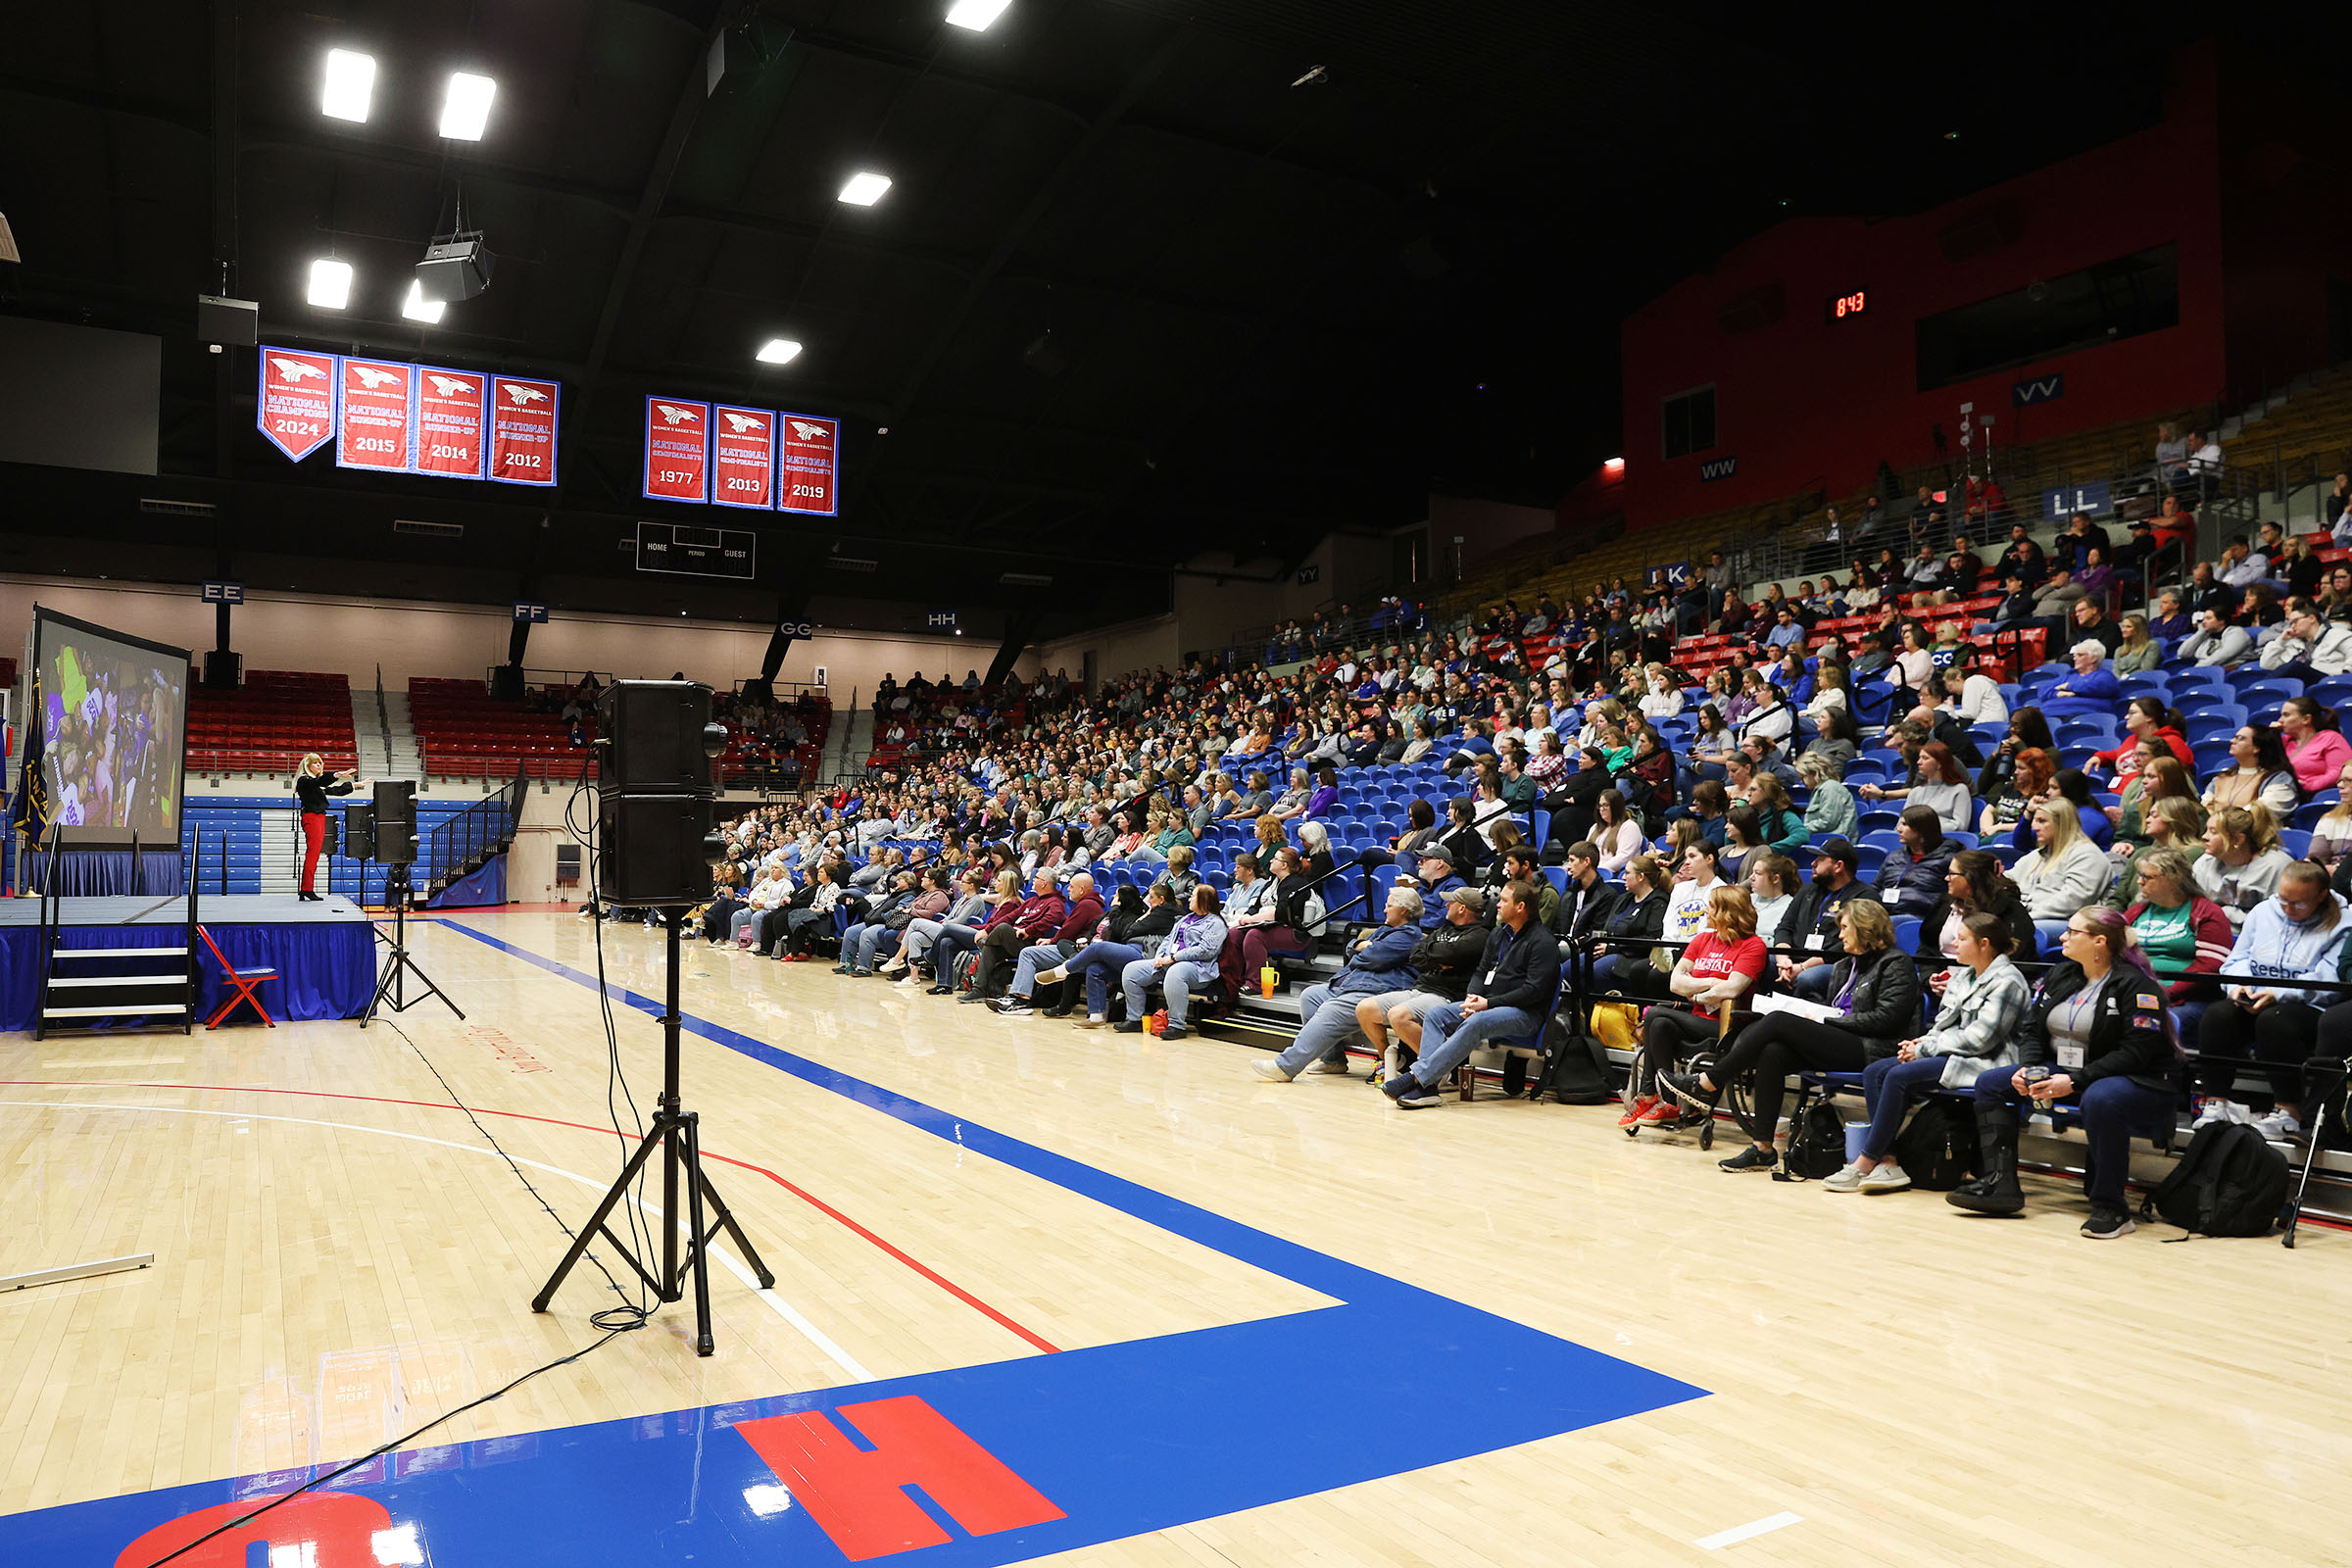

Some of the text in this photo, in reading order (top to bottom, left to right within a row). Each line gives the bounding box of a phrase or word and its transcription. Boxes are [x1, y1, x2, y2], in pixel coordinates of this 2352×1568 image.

[1837, 291, 1864, 318] 843
[295, 386, 328, 395] BASKETBALL
[2016, 377, 2057, 402] VV
[268, 395, 328, 410] NATIONAL
[267, 404, 328, 418] CHAMPIONS
[347, 405, 405, 418] NATIONAL
[423, 412, 478, 426] NATIONAL
[275, 419, 319, 436] 2024
[498, 420, 551, 434] NATIONAL
[356, 437, 395, 453] 2015
[431, 444, 467, 460] 2014
[653, 439, 702, 453] NATIONAL
[506, 453, 541, 467] 2012
[720, 447, 768, 461] NATIONAL
[786, 455, 831, 467] NATIONAL
[1701, 460, 1735, 478] WW
[660, 470, 694, 484] 1977
[727, 477, 760, 492] 2013
[792, 484, 824, 498] 2019
[2054, 490, 2098, 514] LL
[206, 584, 240, 600] EE
[515, 605, 545, 618] FF
[929, 613, 956, 625] HH
[781, 622, 811, 636] GG
[1931, 652, 1953, 665] CC
